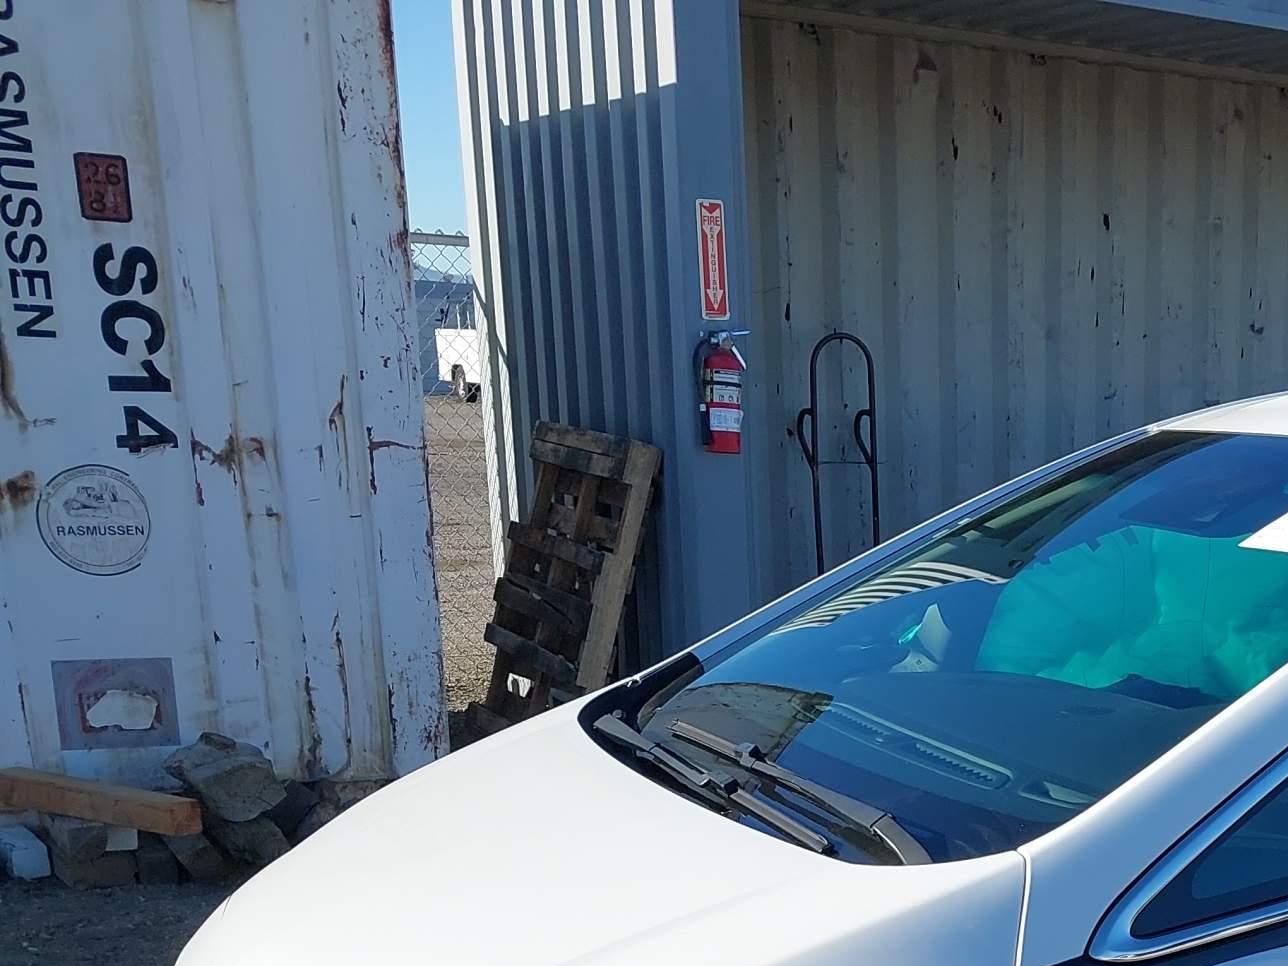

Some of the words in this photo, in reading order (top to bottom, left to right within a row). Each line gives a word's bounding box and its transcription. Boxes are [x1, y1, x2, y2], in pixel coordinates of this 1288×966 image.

[0, 0, 57, 338] SMUSSEN
[702, 214, 721, 227] FIRE
[709, 226, 719, 305] EXTINGUISHER
[93, 242, 179, 454] SC14
[56, 525, 145, 537] RASMUSSEN
